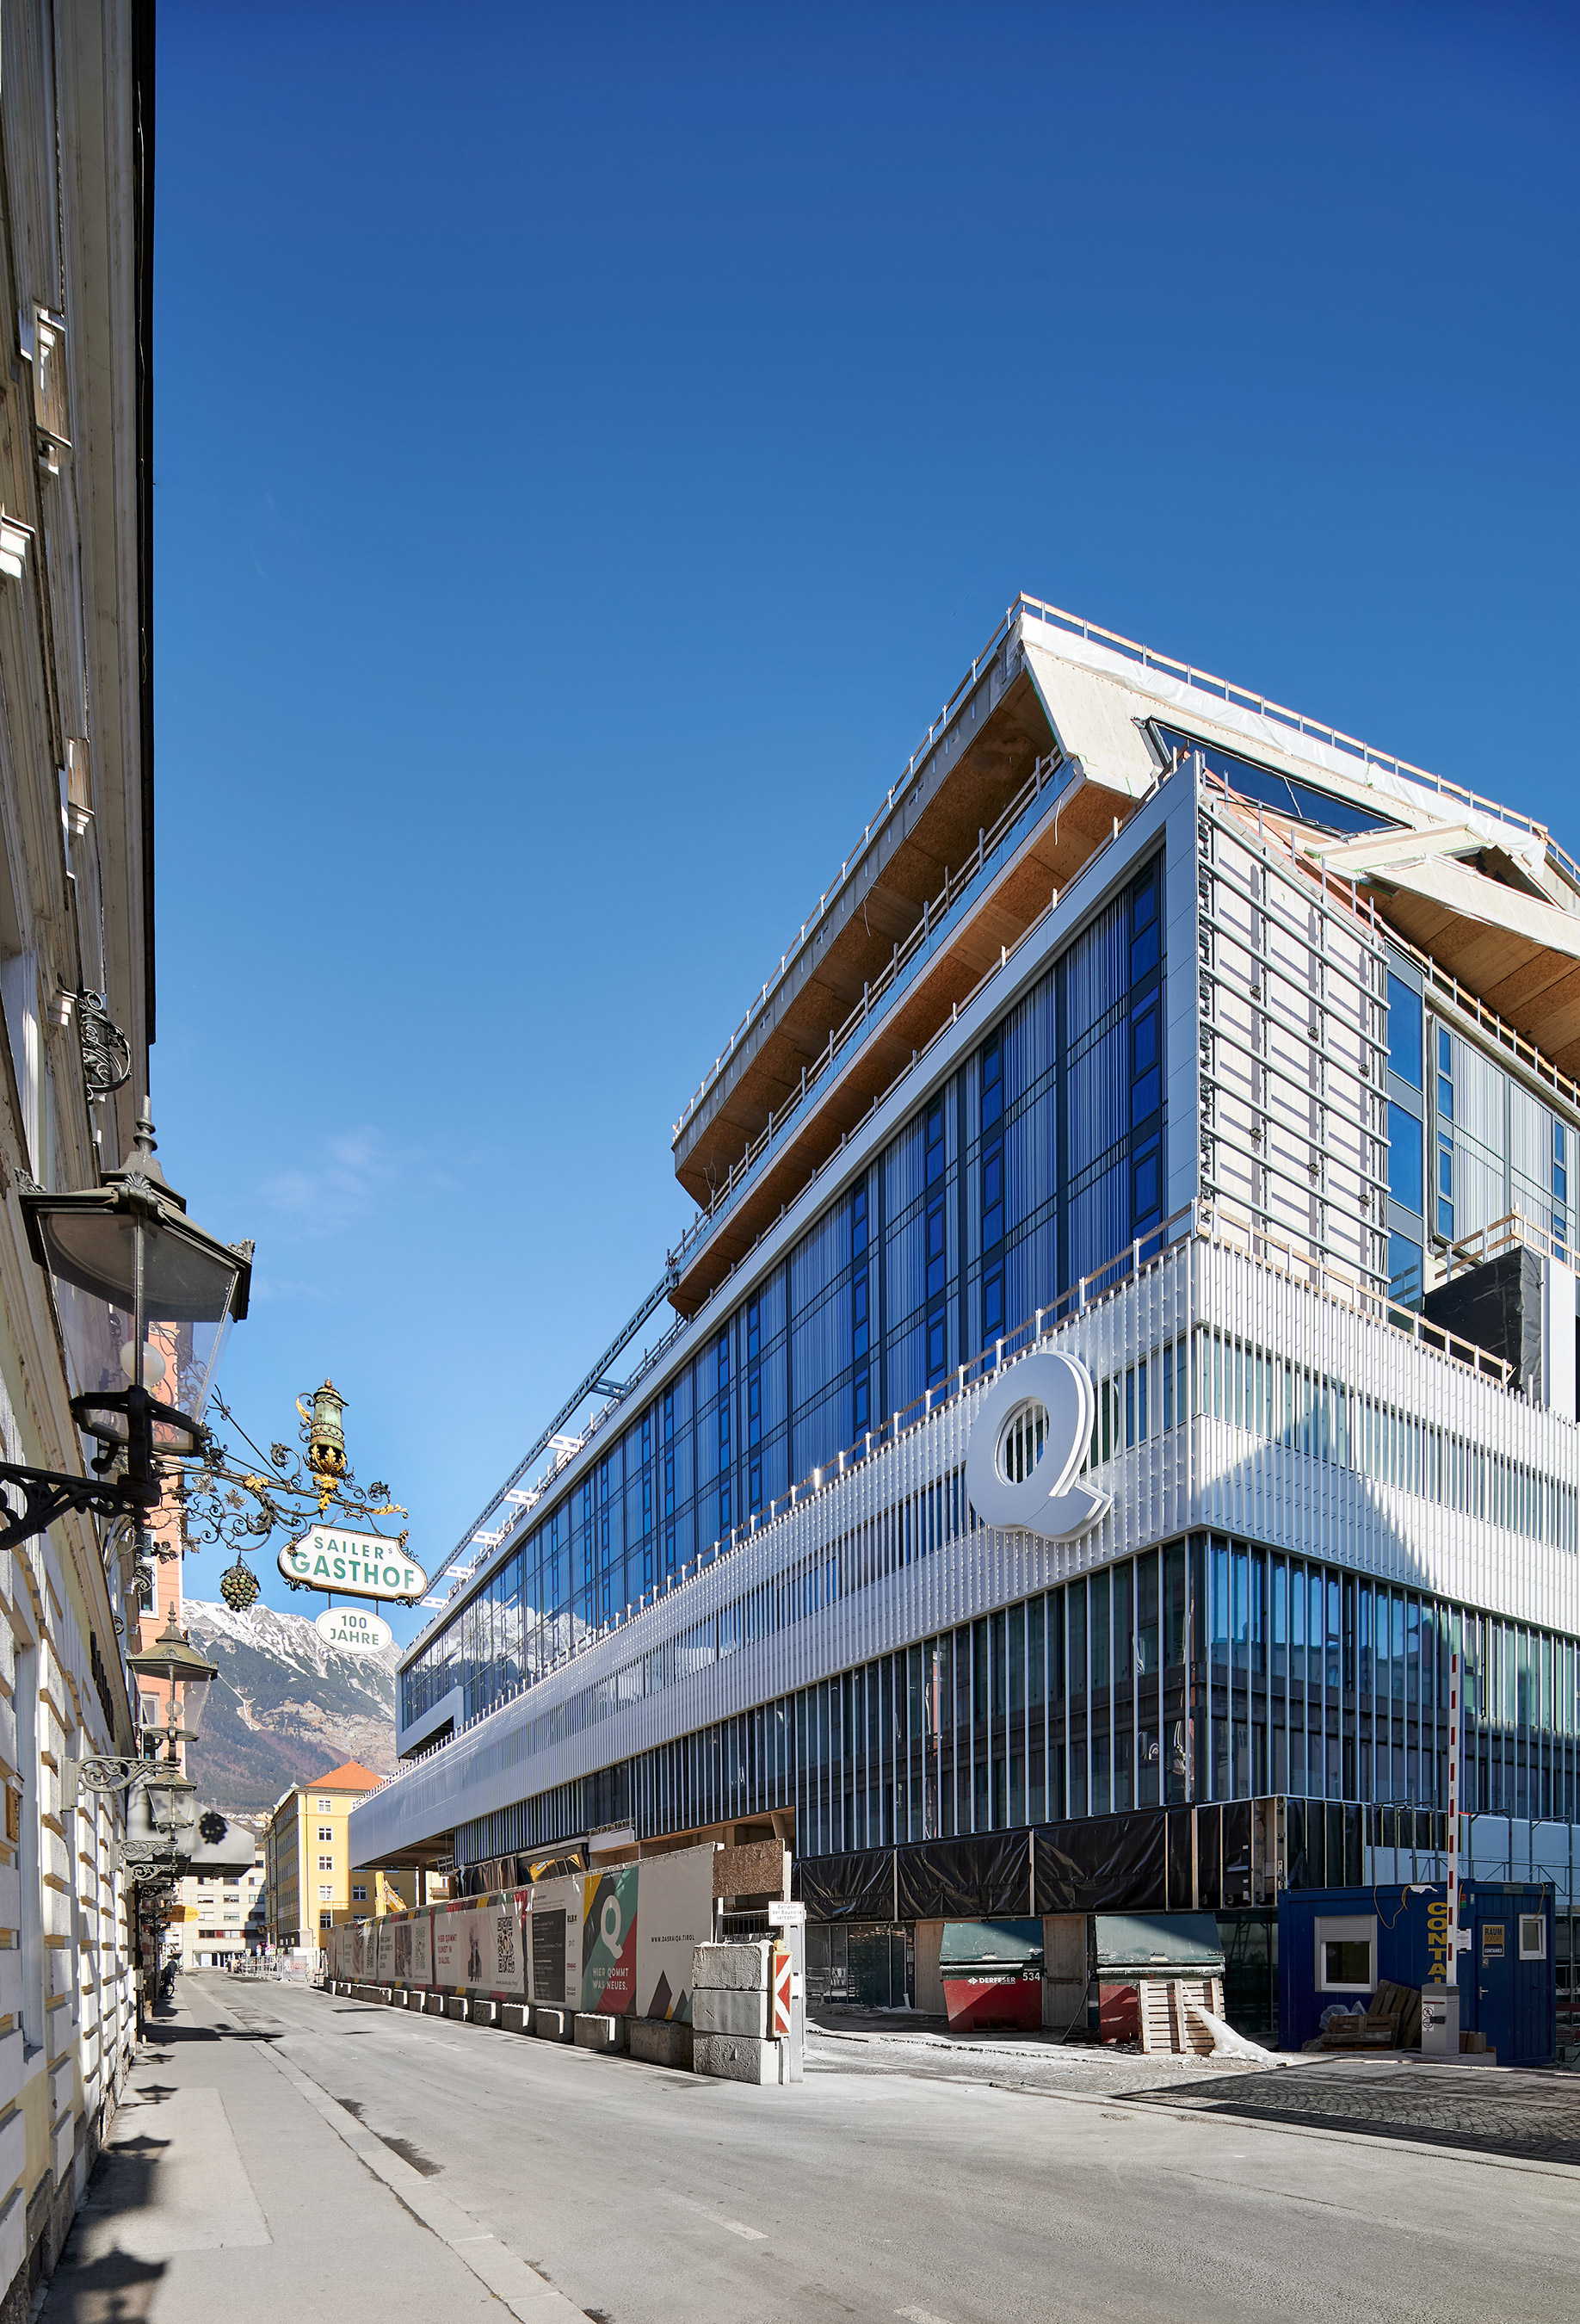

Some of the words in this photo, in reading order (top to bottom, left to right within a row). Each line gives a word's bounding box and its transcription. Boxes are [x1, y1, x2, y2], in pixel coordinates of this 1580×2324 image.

[291, 1551, 414, 1590] GASTHOF
[341, 1615, 367, 1629] 100
[330, 1628, 380, 1646] JAHRE
[600, 1894, 624, 1960] Q
[1484, 1927, 1503, 1936] RAUM
[651, 1934, 695, 1943] WWW.DASRAIQA.TIROL
[592, 1968, 606, 1977] HIER
[607, 1967, 629, 1979] QOMMT
[1021, 1972, 1041, 1981] 534
[592, 1980, 606, 1990] WAS
[607, 1981, 628, 1991] NEUES.
